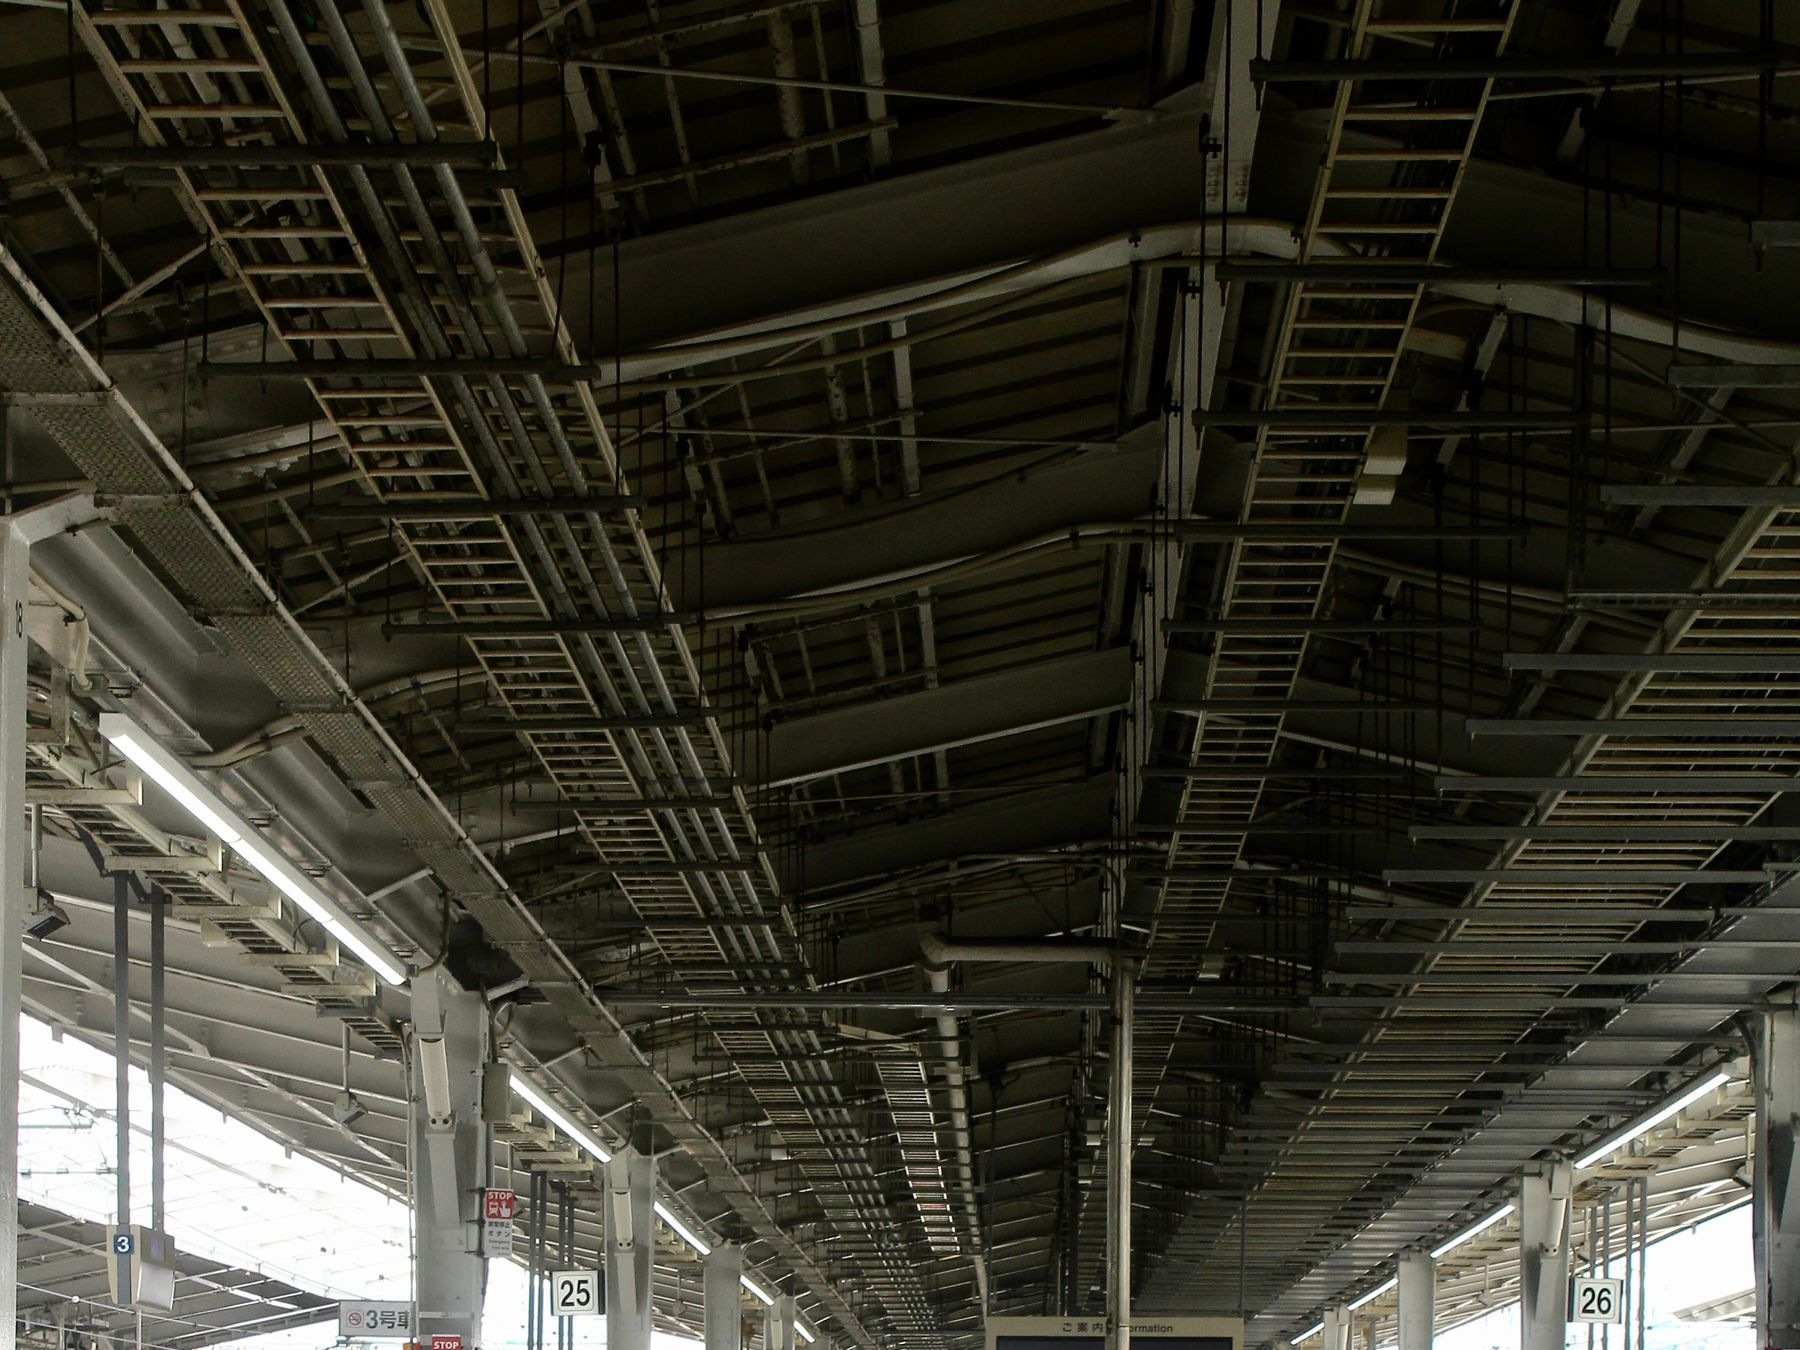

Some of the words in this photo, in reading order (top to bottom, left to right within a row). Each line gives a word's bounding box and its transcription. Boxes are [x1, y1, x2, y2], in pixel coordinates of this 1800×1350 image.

[488, 1191, 512, 1200] STOP
[117, 1236, 130, 1252] 3
[560, 1280, 591, 1307] 25
[1582, 1287, 1612, 1315] 26
[1129, 1323, 1173, 1333] ormation
[434, 1341, 459, 1350] STOP
